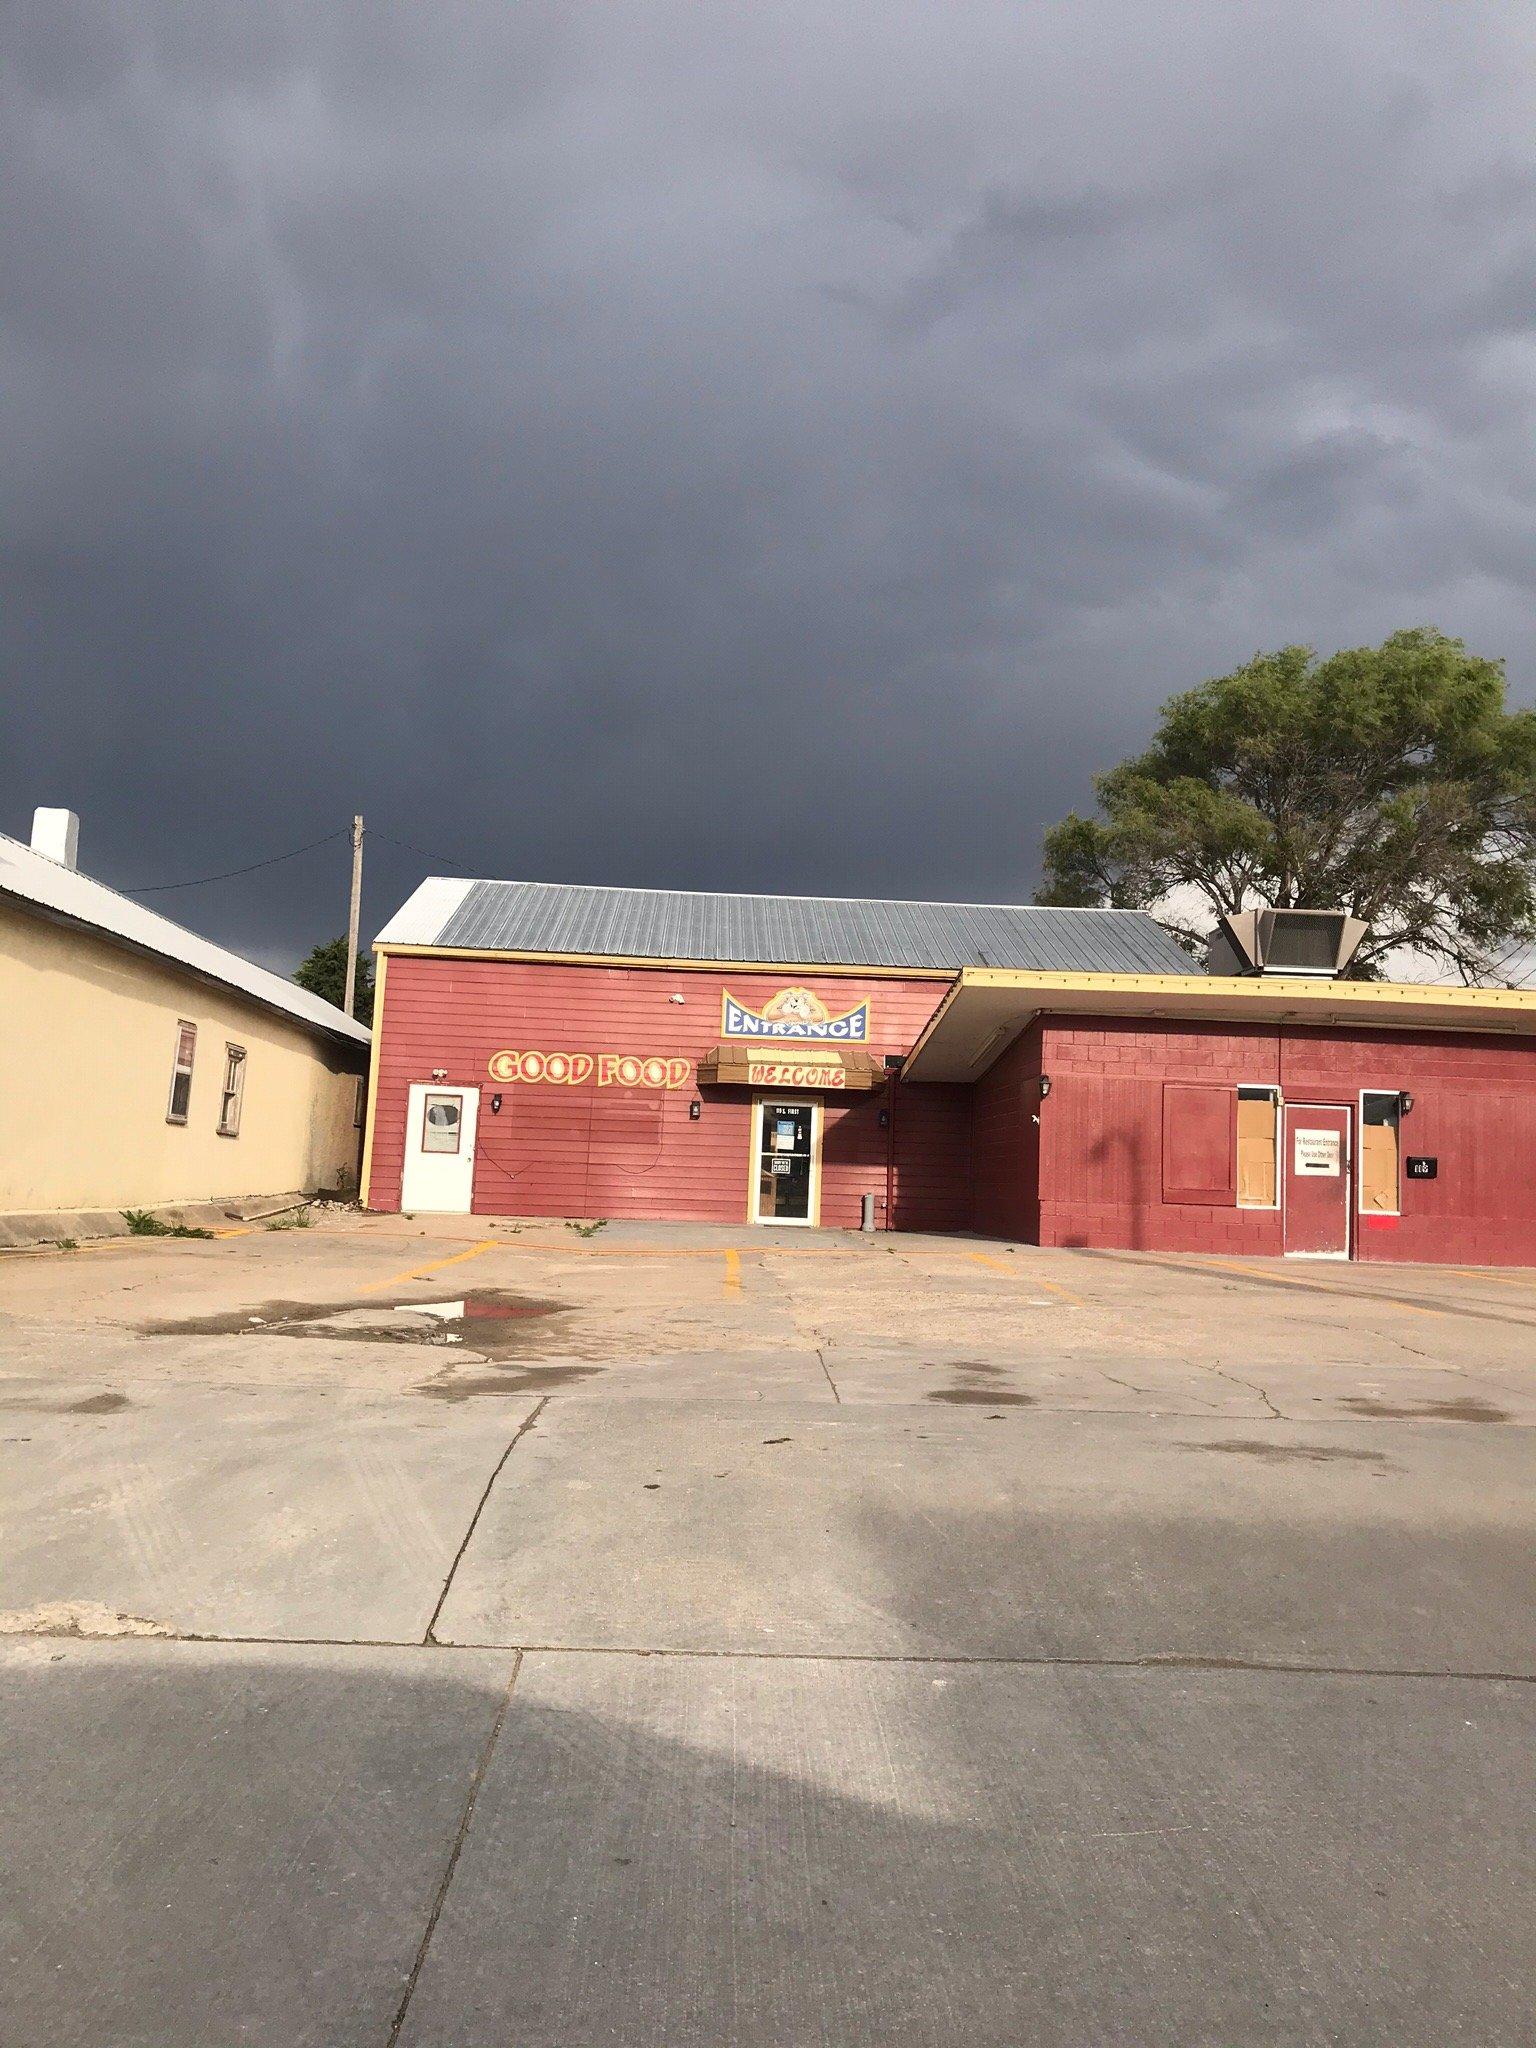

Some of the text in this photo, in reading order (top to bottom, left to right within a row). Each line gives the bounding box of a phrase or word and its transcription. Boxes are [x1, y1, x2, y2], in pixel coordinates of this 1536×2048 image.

[728, 1003, 864, 1038] ENTRANCE
[488, 1050, 691, 1089] GOOD FOOD
[751, 1065, 845, 1087] WELCOME
